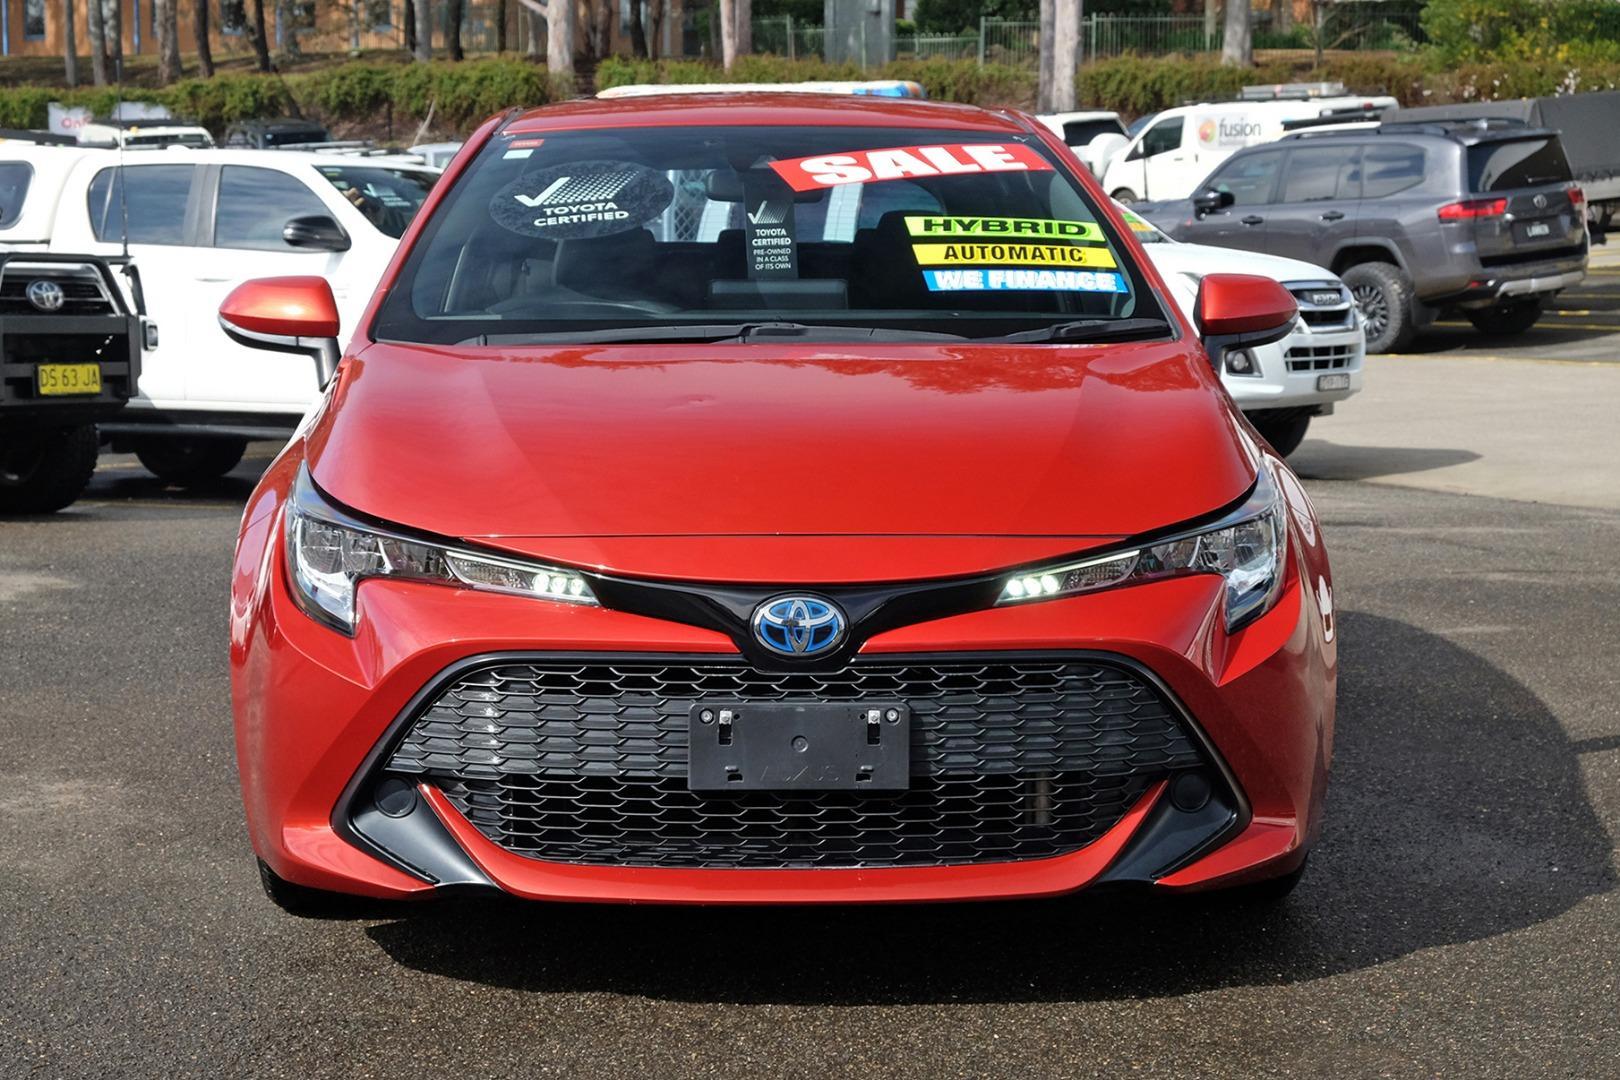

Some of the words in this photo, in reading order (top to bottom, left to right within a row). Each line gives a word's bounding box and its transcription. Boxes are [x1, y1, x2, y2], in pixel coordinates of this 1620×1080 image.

[1219, 117, 1261, 137] fusion
[799, 145, 1025, 184] SALE
[543, 202, 618, 216] TOYOTA
[534, 210, 629, 227] CERTIFIED
[923, 218, 1087, 237] HYBRID
[755, 228, 787, 236] TOYOTA
[752, 237, 791, 246] CERTIFIED
[943, 245, 1084, 262] AUTOMATIC
[934, 270, 984, 289] WE
[988, 270, 1117, 290] FINANCE
[41, 368, 57, 387] DS
[62, 368, 78, 386] 63
[83, 367, 98, 386] JA
